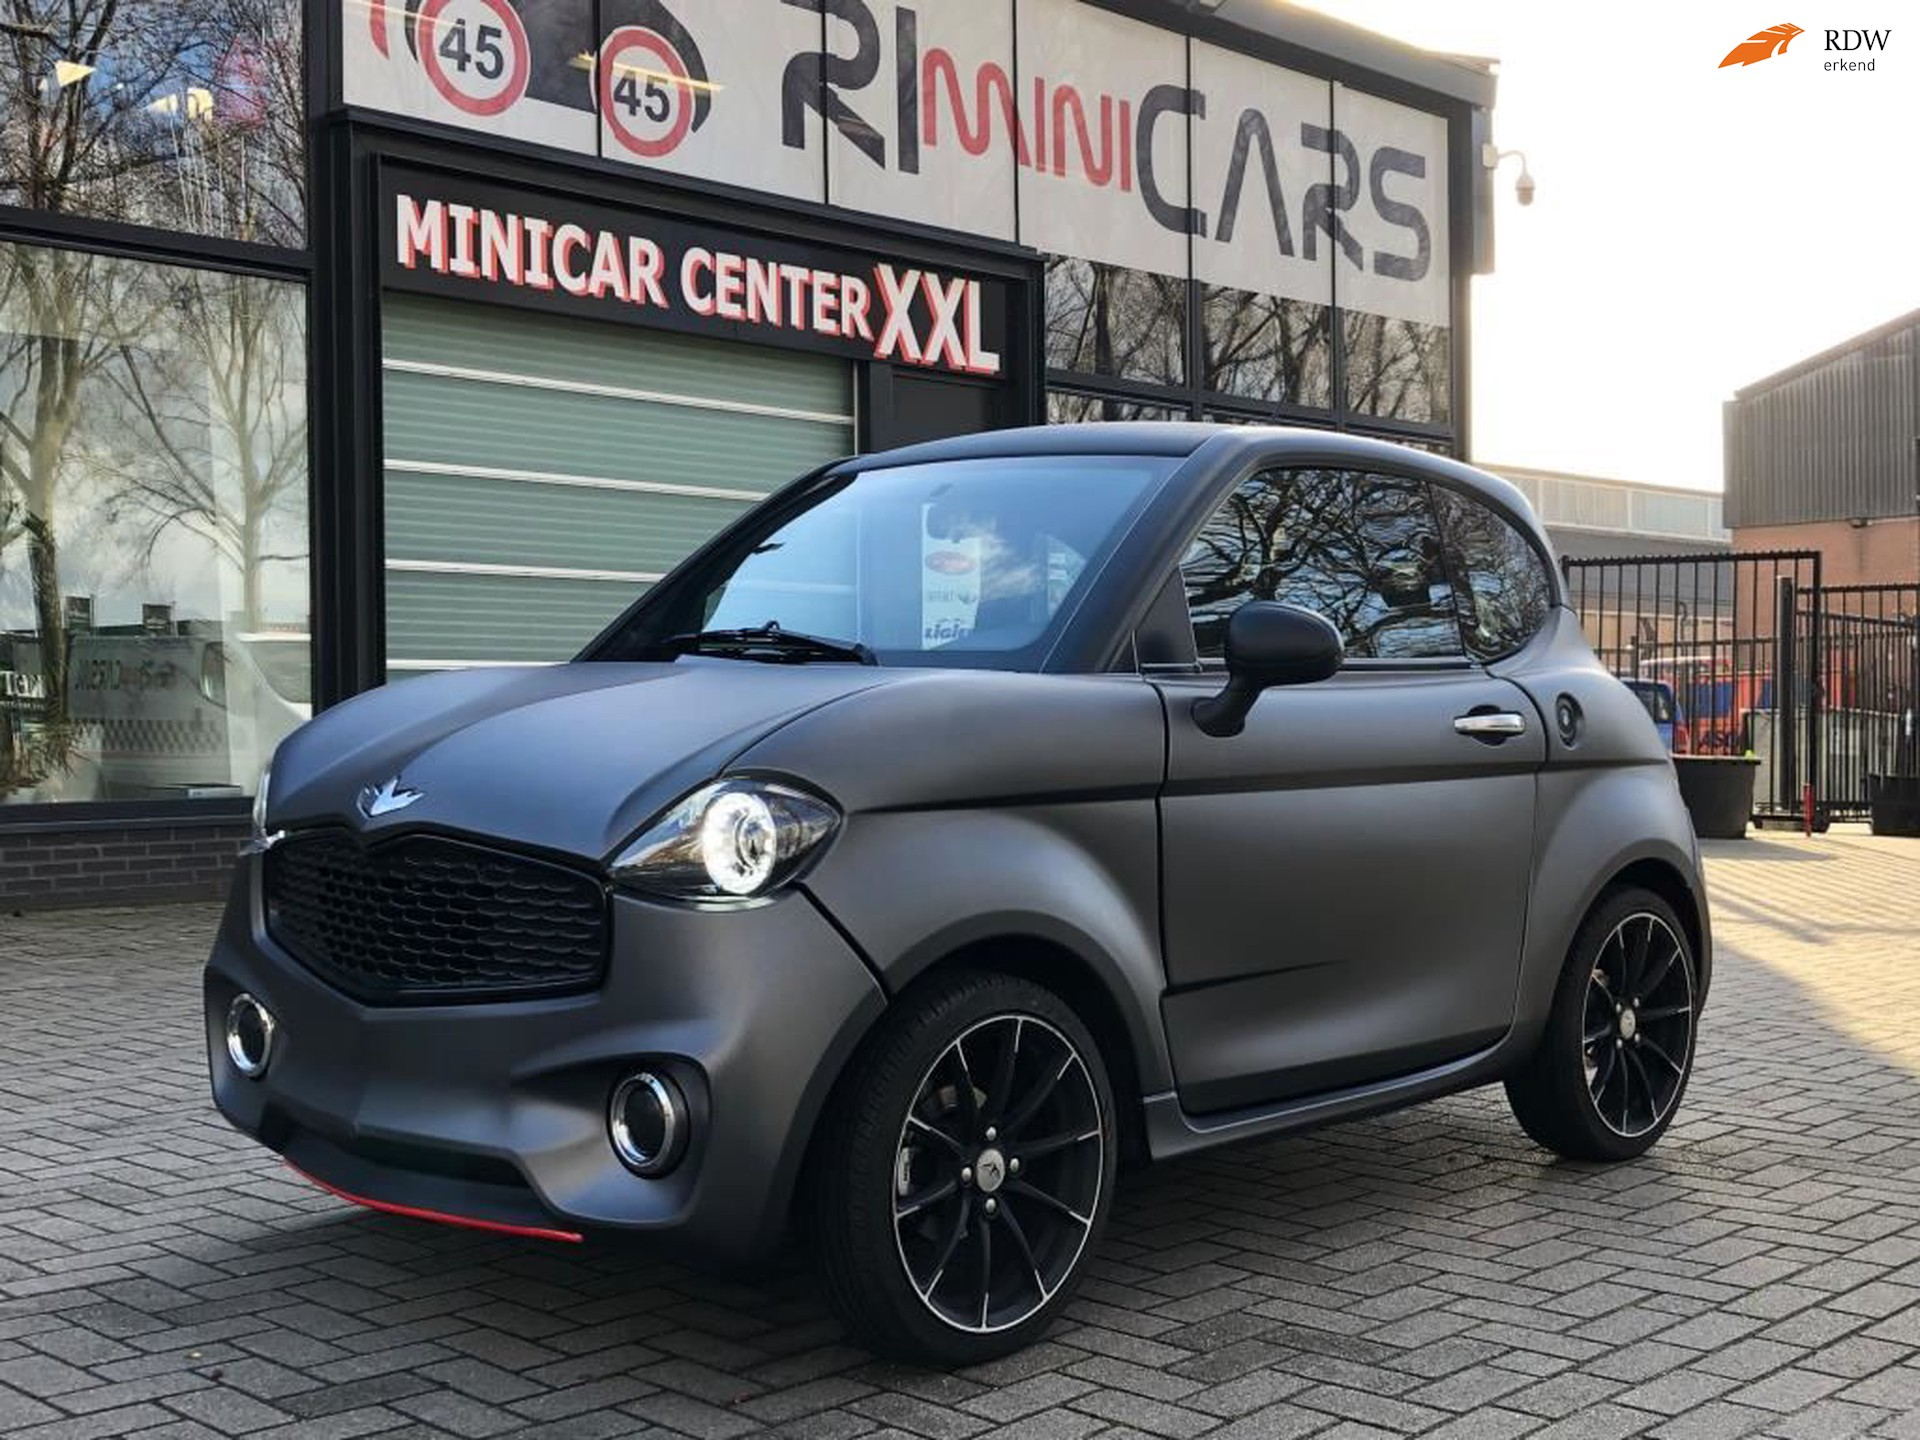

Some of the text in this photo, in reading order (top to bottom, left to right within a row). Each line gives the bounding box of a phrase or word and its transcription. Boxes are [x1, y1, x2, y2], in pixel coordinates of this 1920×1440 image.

[439, 18, 504, 80] 45
[612, 69, 670, 123] 45
[396, 194, 1000, 375] MINICAR CENTER XXL
